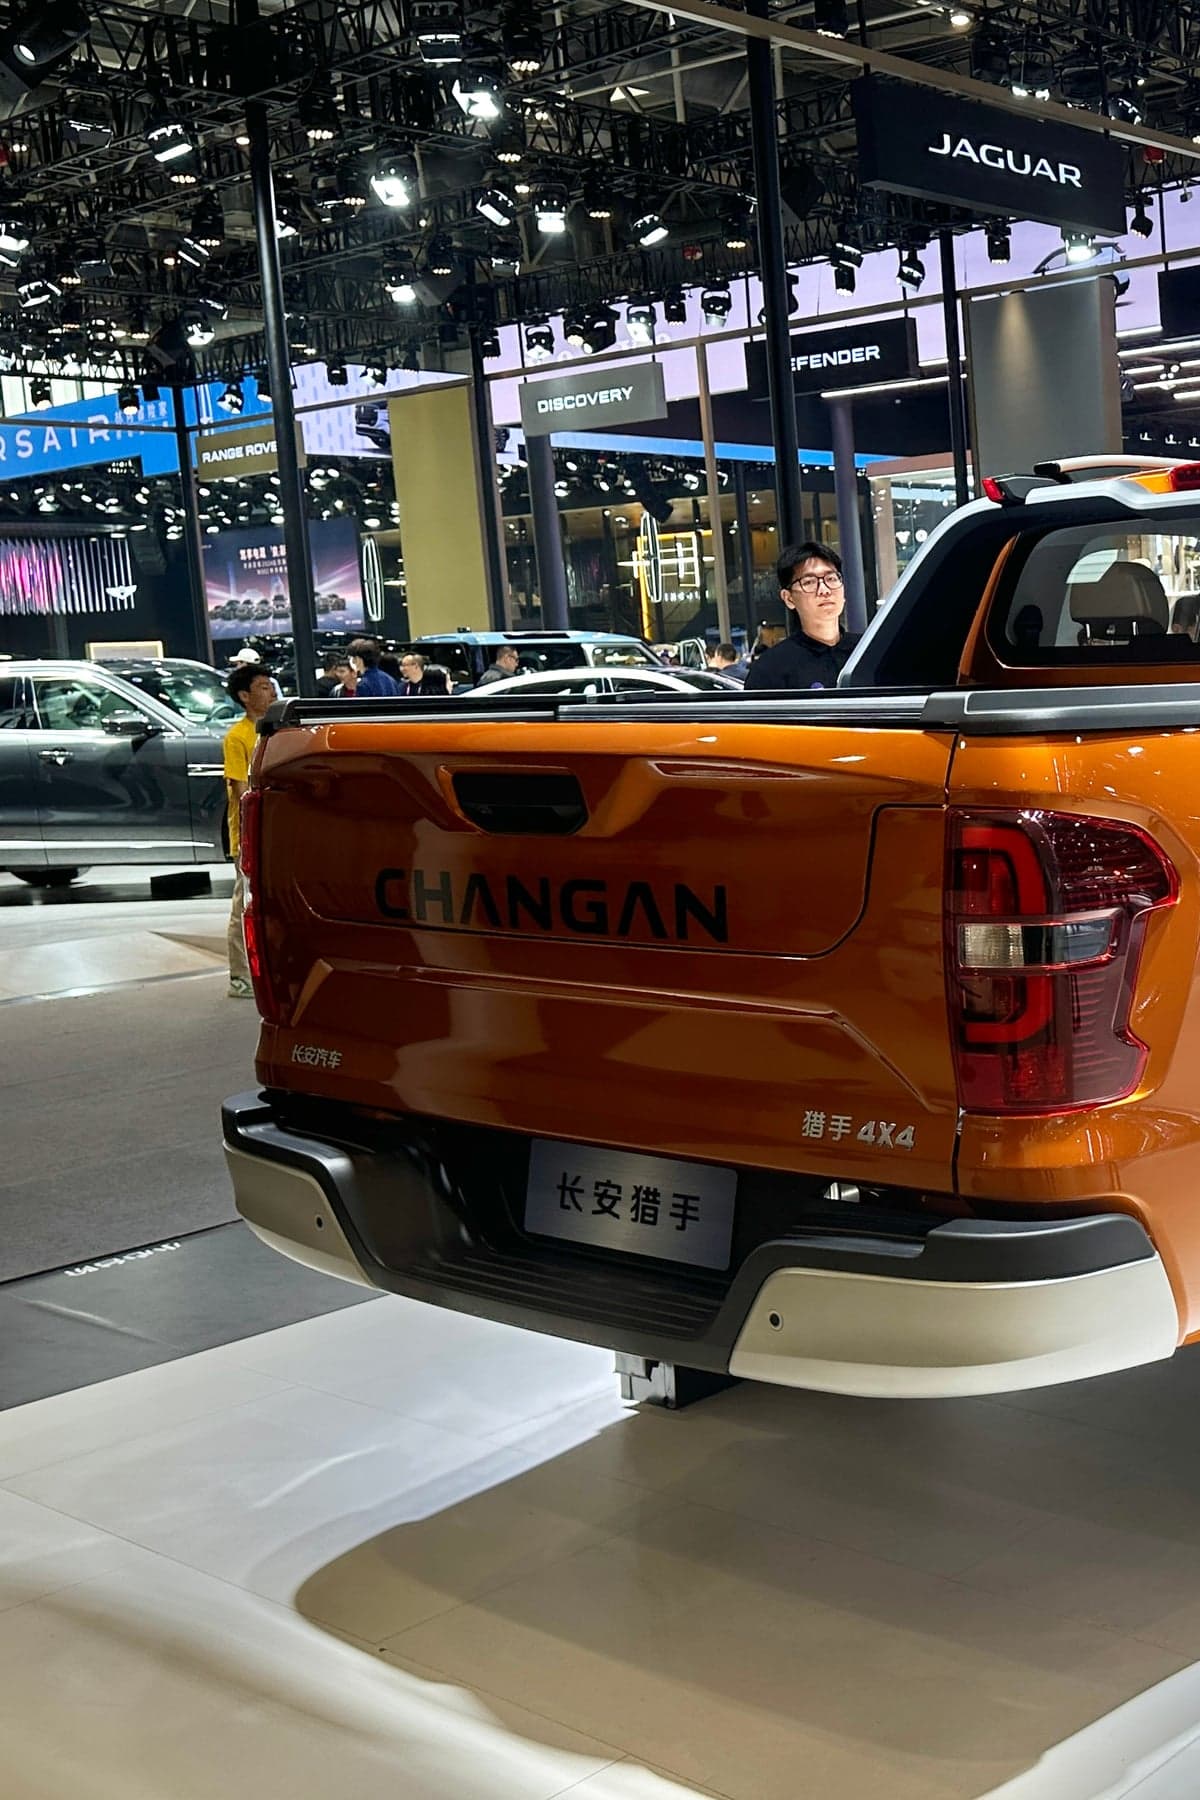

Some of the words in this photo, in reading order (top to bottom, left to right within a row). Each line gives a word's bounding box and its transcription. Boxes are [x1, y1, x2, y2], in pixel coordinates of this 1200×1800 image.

[928, 134, 1082, 188] JAGUAR
[537, 386, 633, 414] DISCOVERY
[202, 446, 244, 464] RANGE
[245, 440, 278, 457] ROVE
[374, 868, 728, 943] CHANGAN
[291, 1044, 343, 1069] 长安汽车
[802, 1110, 853, 1141] 猎手
[857, 1120, 915, 1151] 4X4
[556, 1172, 701, 1231] 长安猎手
